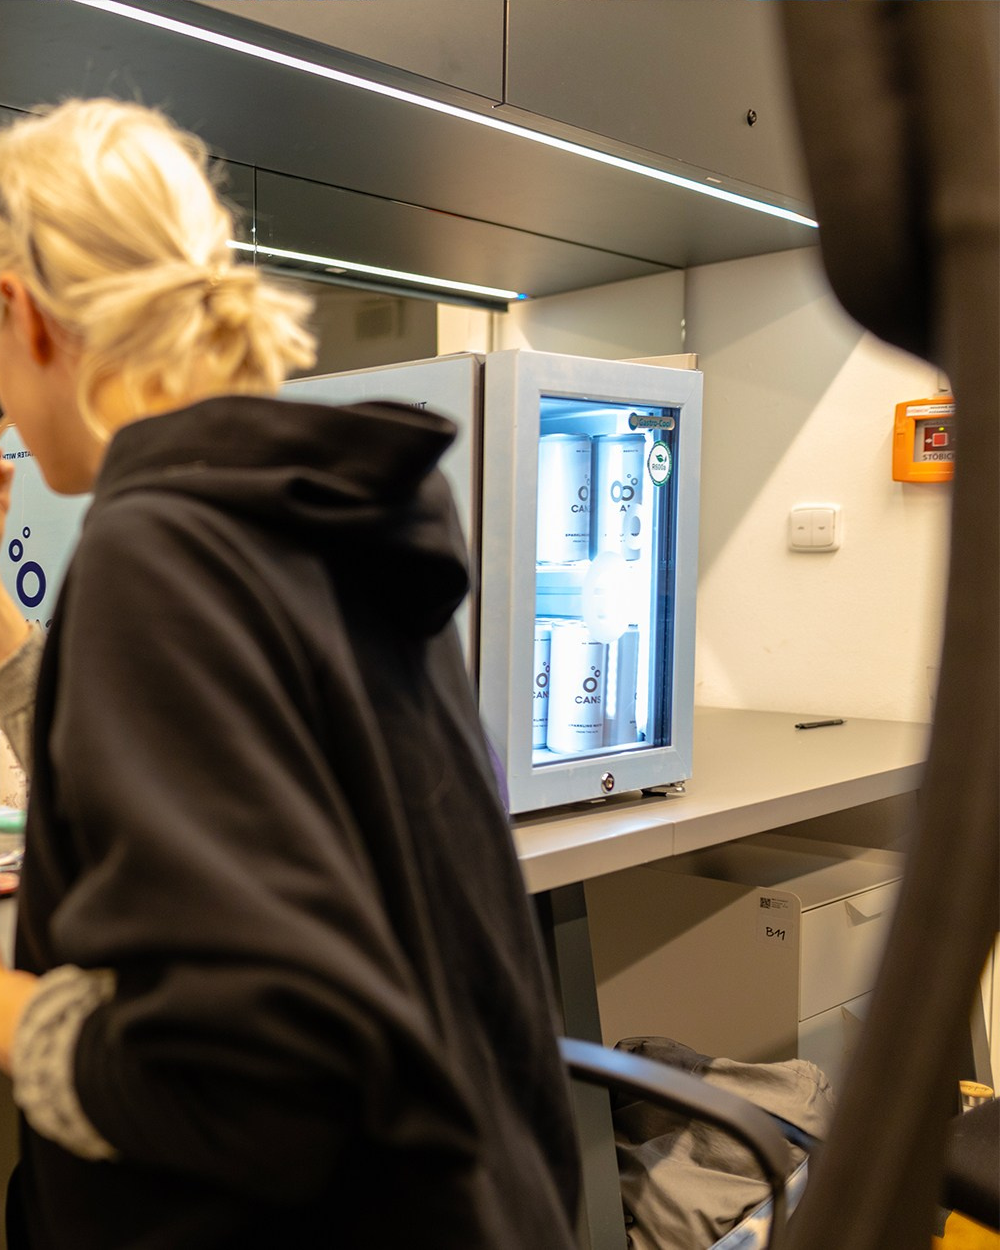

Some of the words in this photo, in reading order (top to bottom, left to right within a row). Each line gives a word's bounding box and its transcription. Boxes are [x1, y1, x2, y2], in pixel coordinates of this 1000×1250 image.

[639, 418, 672, 428] Gastro-Cool
[923, 452, 953, 461] STÖBIC
[766, 926, 785, 941] B11
